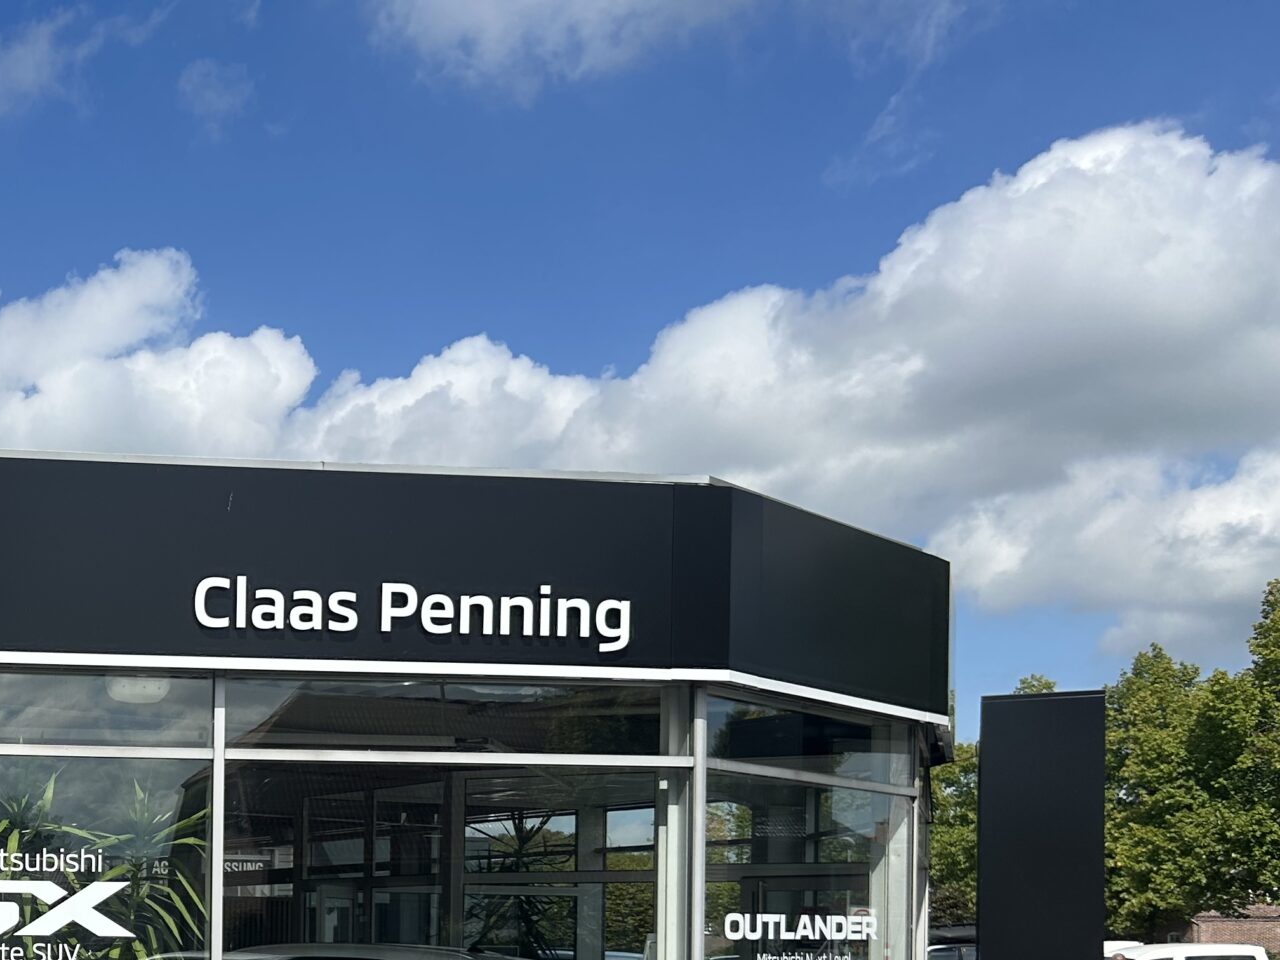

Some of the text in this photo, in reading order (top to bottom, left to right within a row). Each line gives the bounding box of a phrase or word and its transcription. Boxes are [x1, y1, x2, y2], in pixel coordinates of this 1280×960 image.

[193, 575, 631, 653] Claas Penning
[724, 912, 879, 941] OUTLANDER
